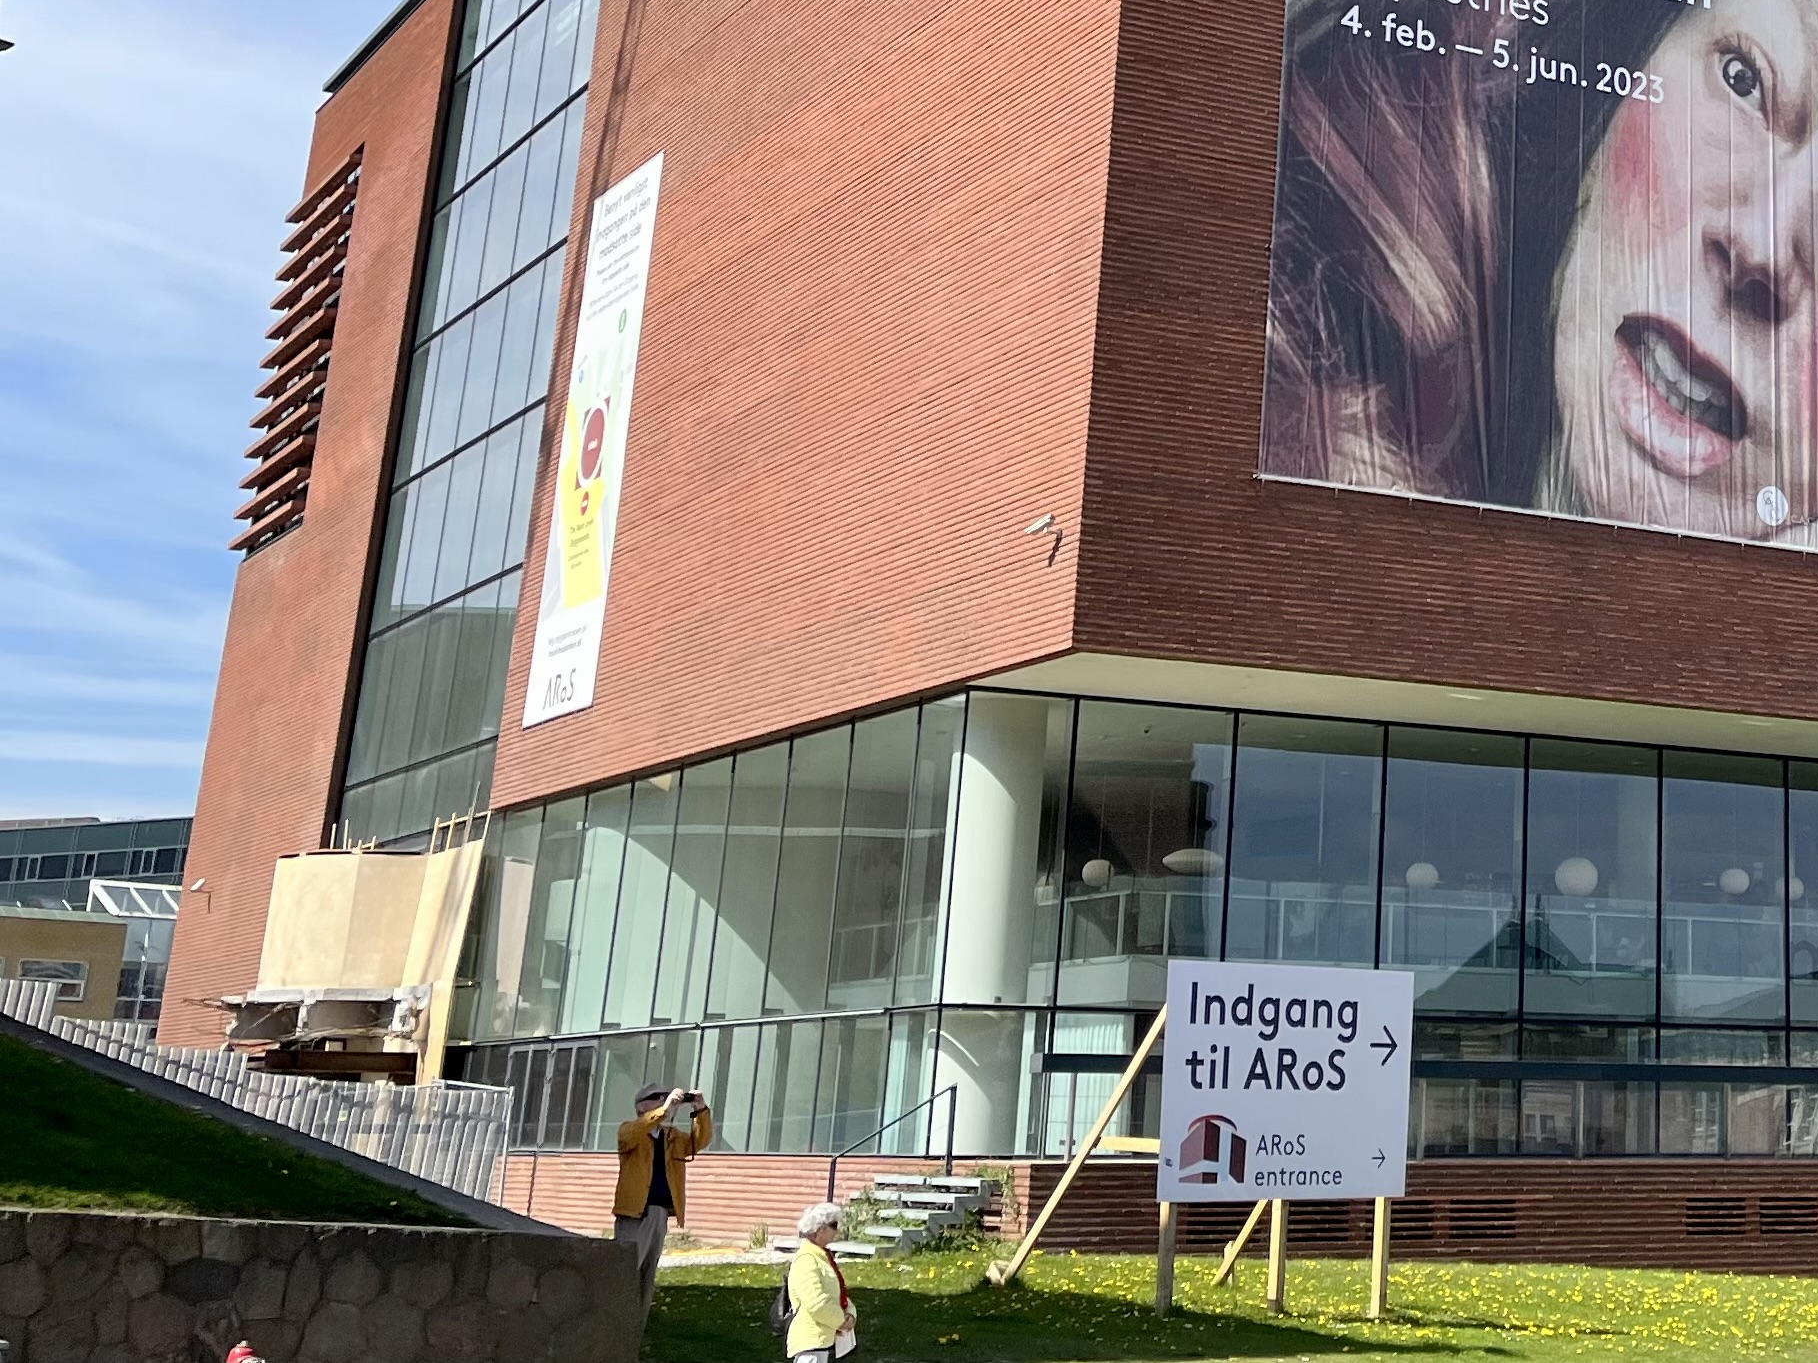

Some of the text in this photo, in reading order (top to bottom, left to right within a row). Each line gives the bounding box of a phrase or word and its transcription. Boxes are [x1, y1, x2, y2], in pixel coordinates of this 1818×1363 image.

[1341, 5, 1372, 37] 4.
[1382, 13, 1446, 55] feb.
[1492, 40, 1519, 71] 5.
[1526, 47, 1588, 87] jun.
[1596, 63, 1665, 104] 2023
[1189, 981, 1359, 1043] Indgang
[1185, 1044, 1346, 1091] til ARoS
[1256, 1134, 1306, 1156] ARoS
[1254, 1168, 1342, 1187] entrance
